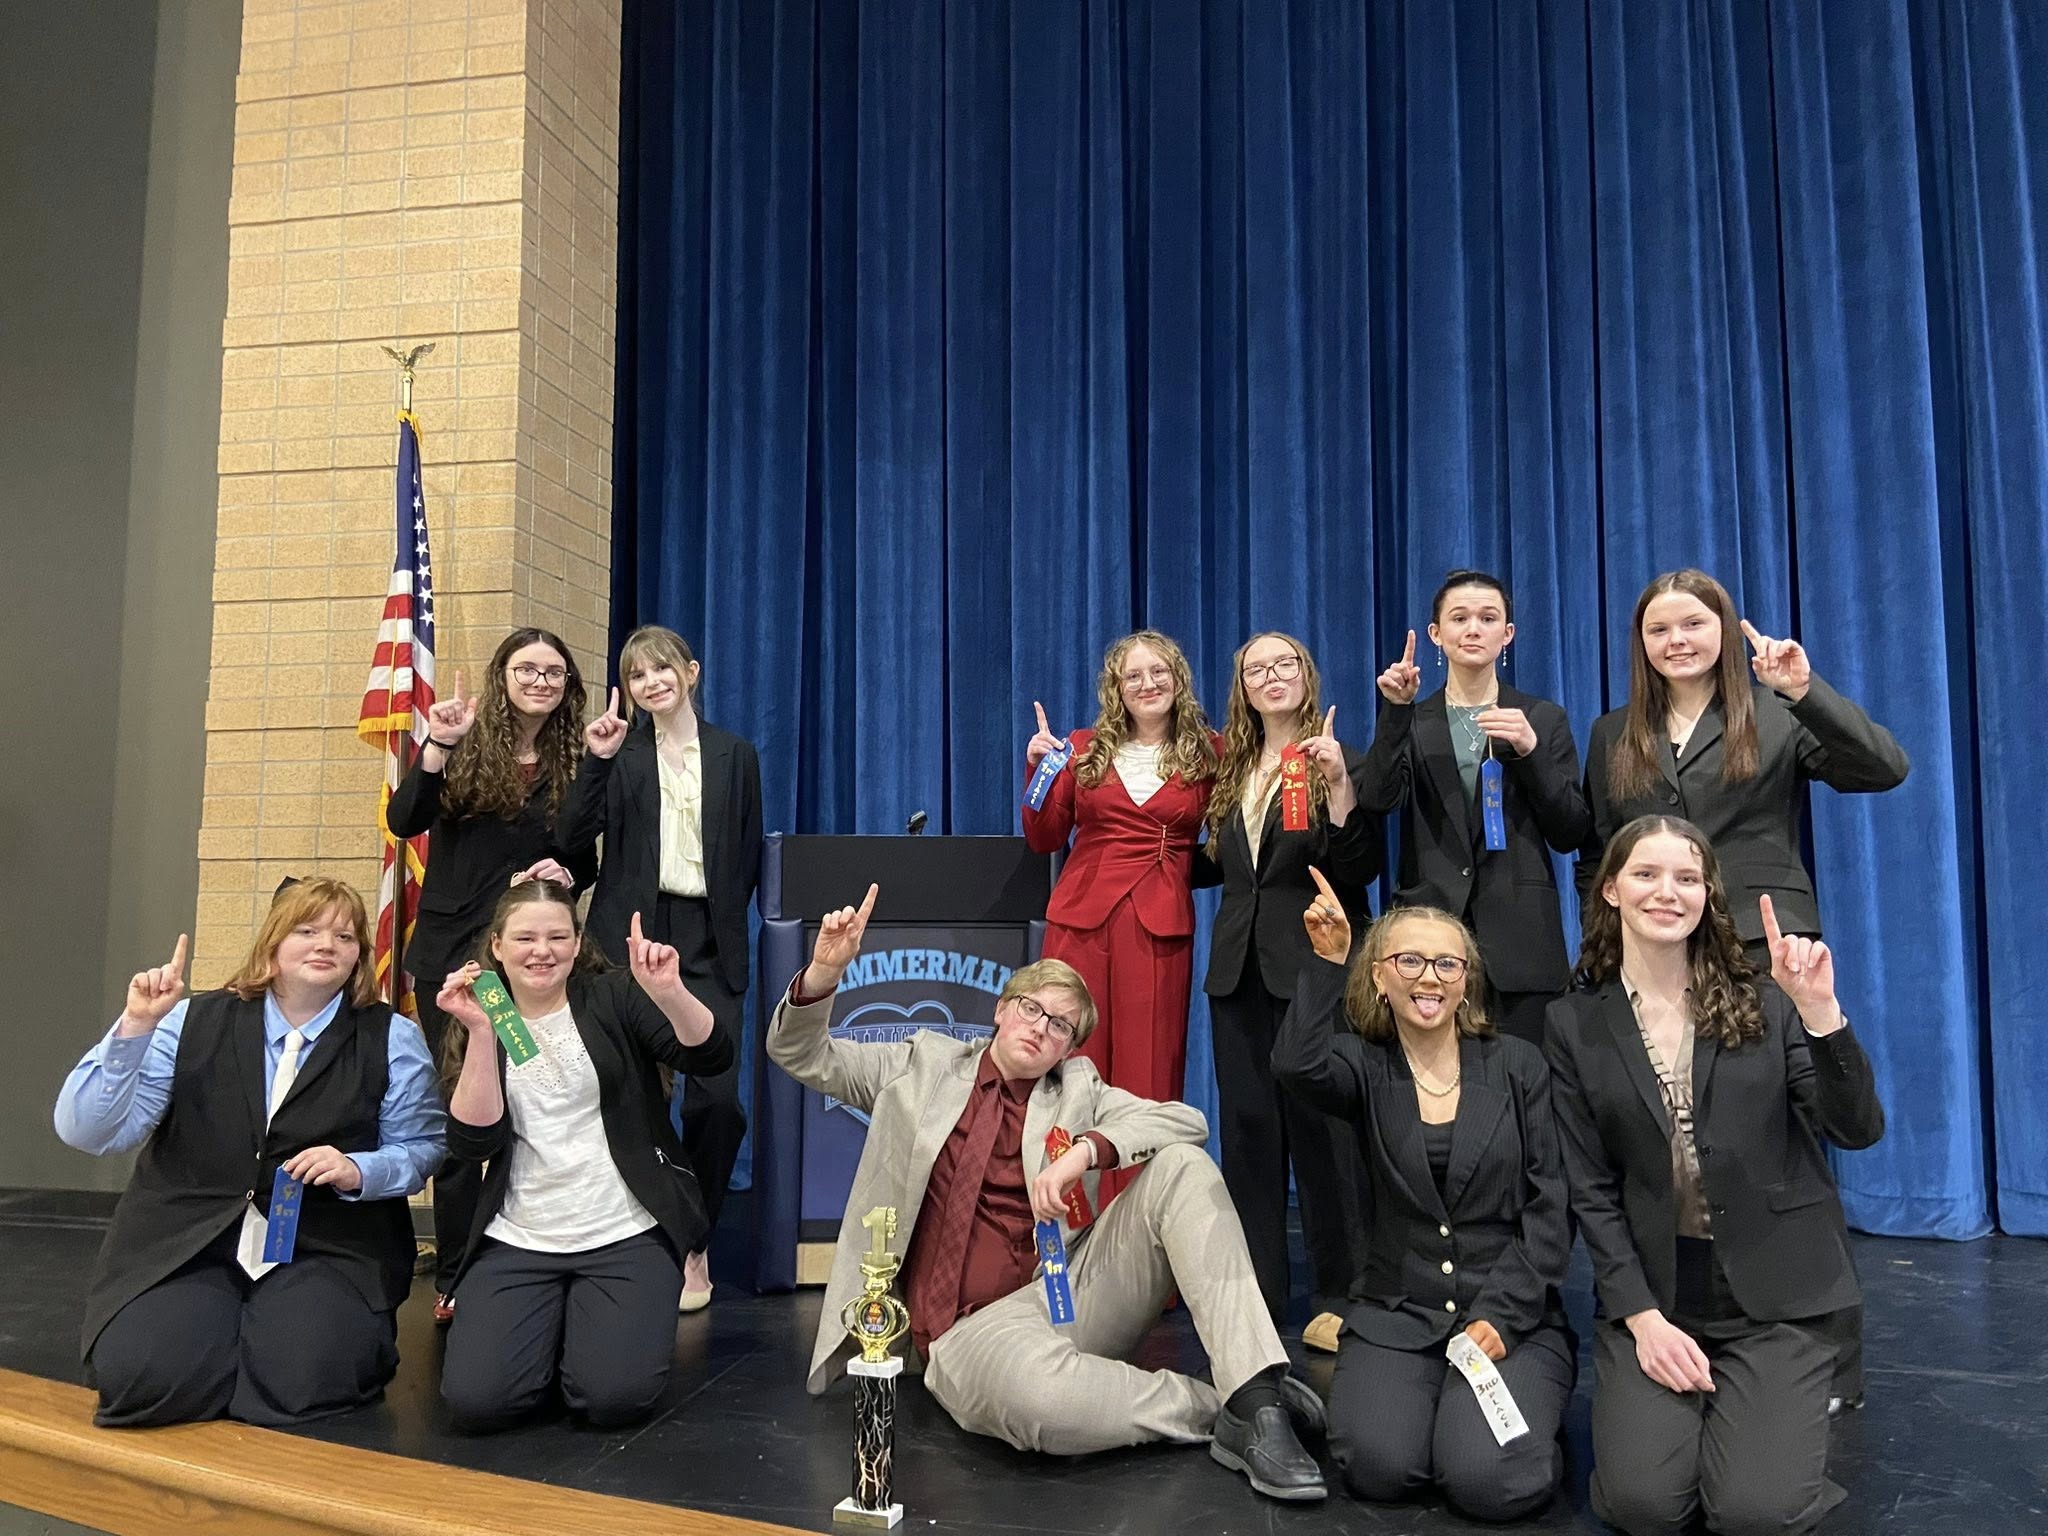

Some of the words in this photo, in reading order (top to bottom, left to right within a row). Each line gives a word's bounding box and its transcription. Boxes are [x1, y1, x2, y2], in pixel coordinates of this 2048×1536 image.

[1284, 777, 1304, 790] 2ND
[506, 1022, 529, 1057] PLACE
[1070, 1191, 1082, 1222] LACE
[1053, 1277, 1065, 1319] PLACE
[1475, 1377, 1499, 1397] 3RD
[1489, 1391, 1511, 1428] PLACE
